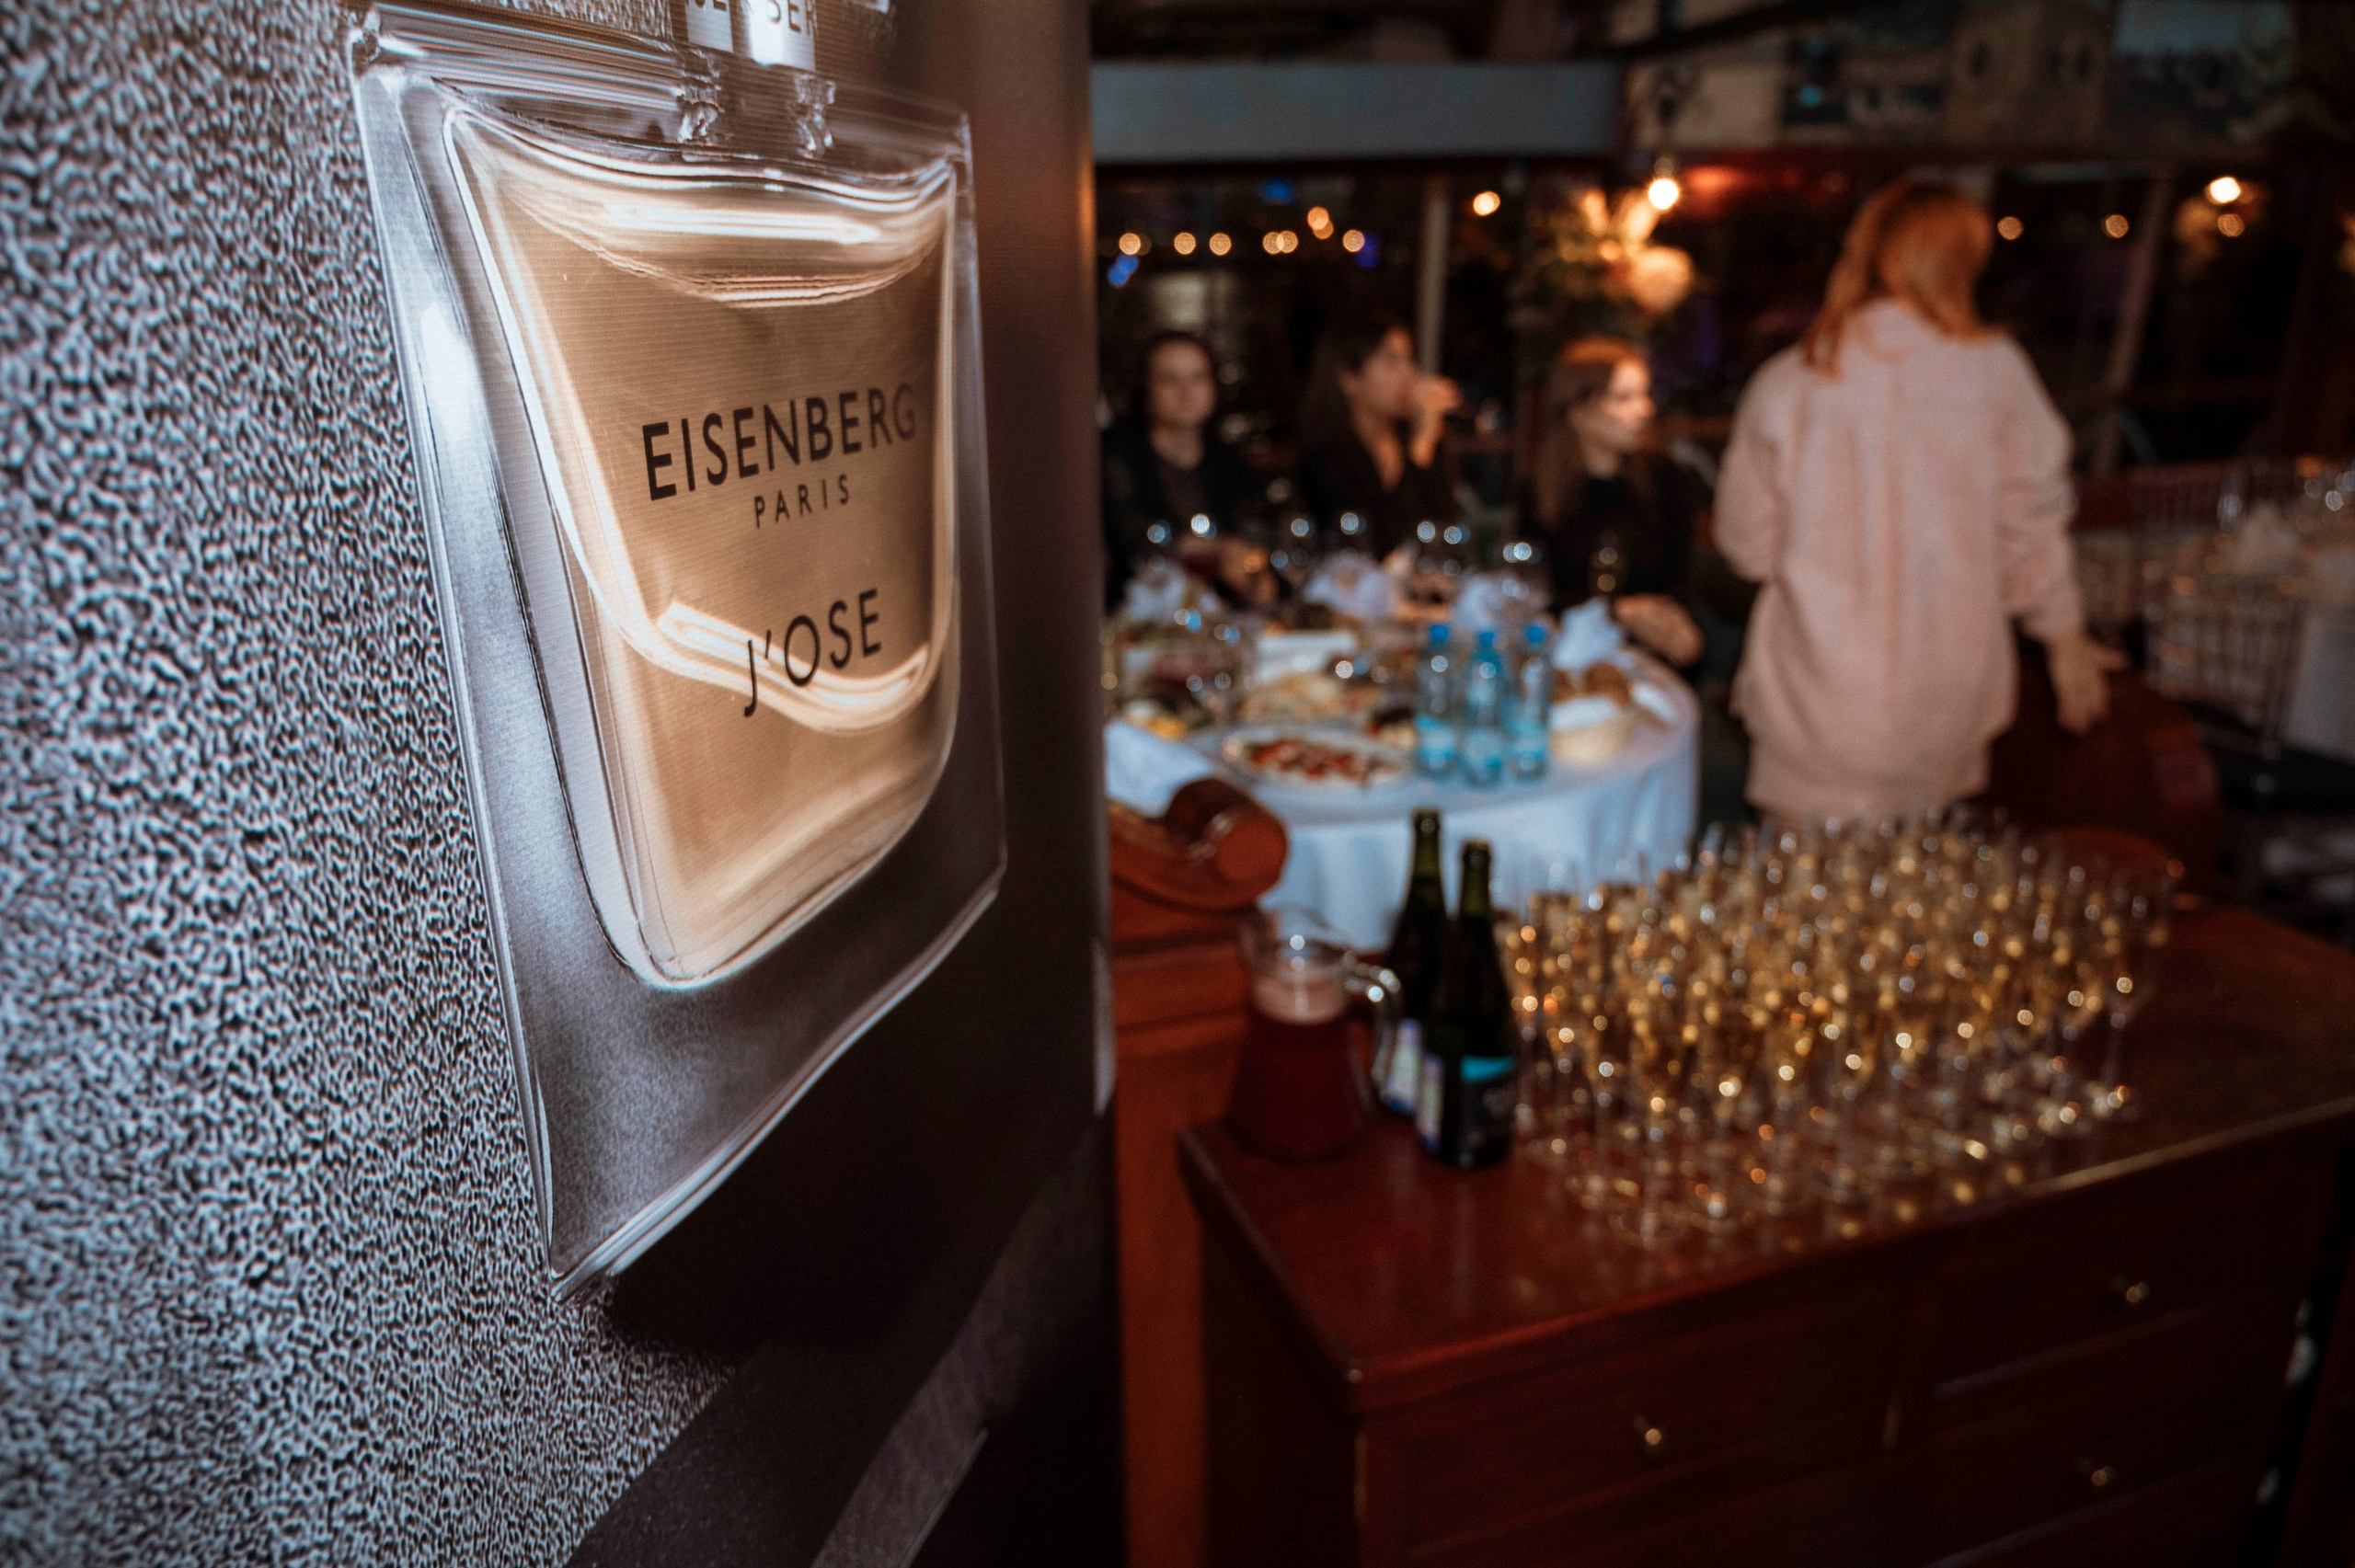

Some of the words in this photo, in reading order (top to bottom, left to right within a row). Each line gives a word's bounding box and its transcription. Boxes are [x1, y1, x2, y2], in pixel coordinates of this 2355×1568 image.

[642, 383, 916, 501] EISENBERG
[754, 474, 850, 530] PARIS
[743, 588, 882, 717] J'OSE
